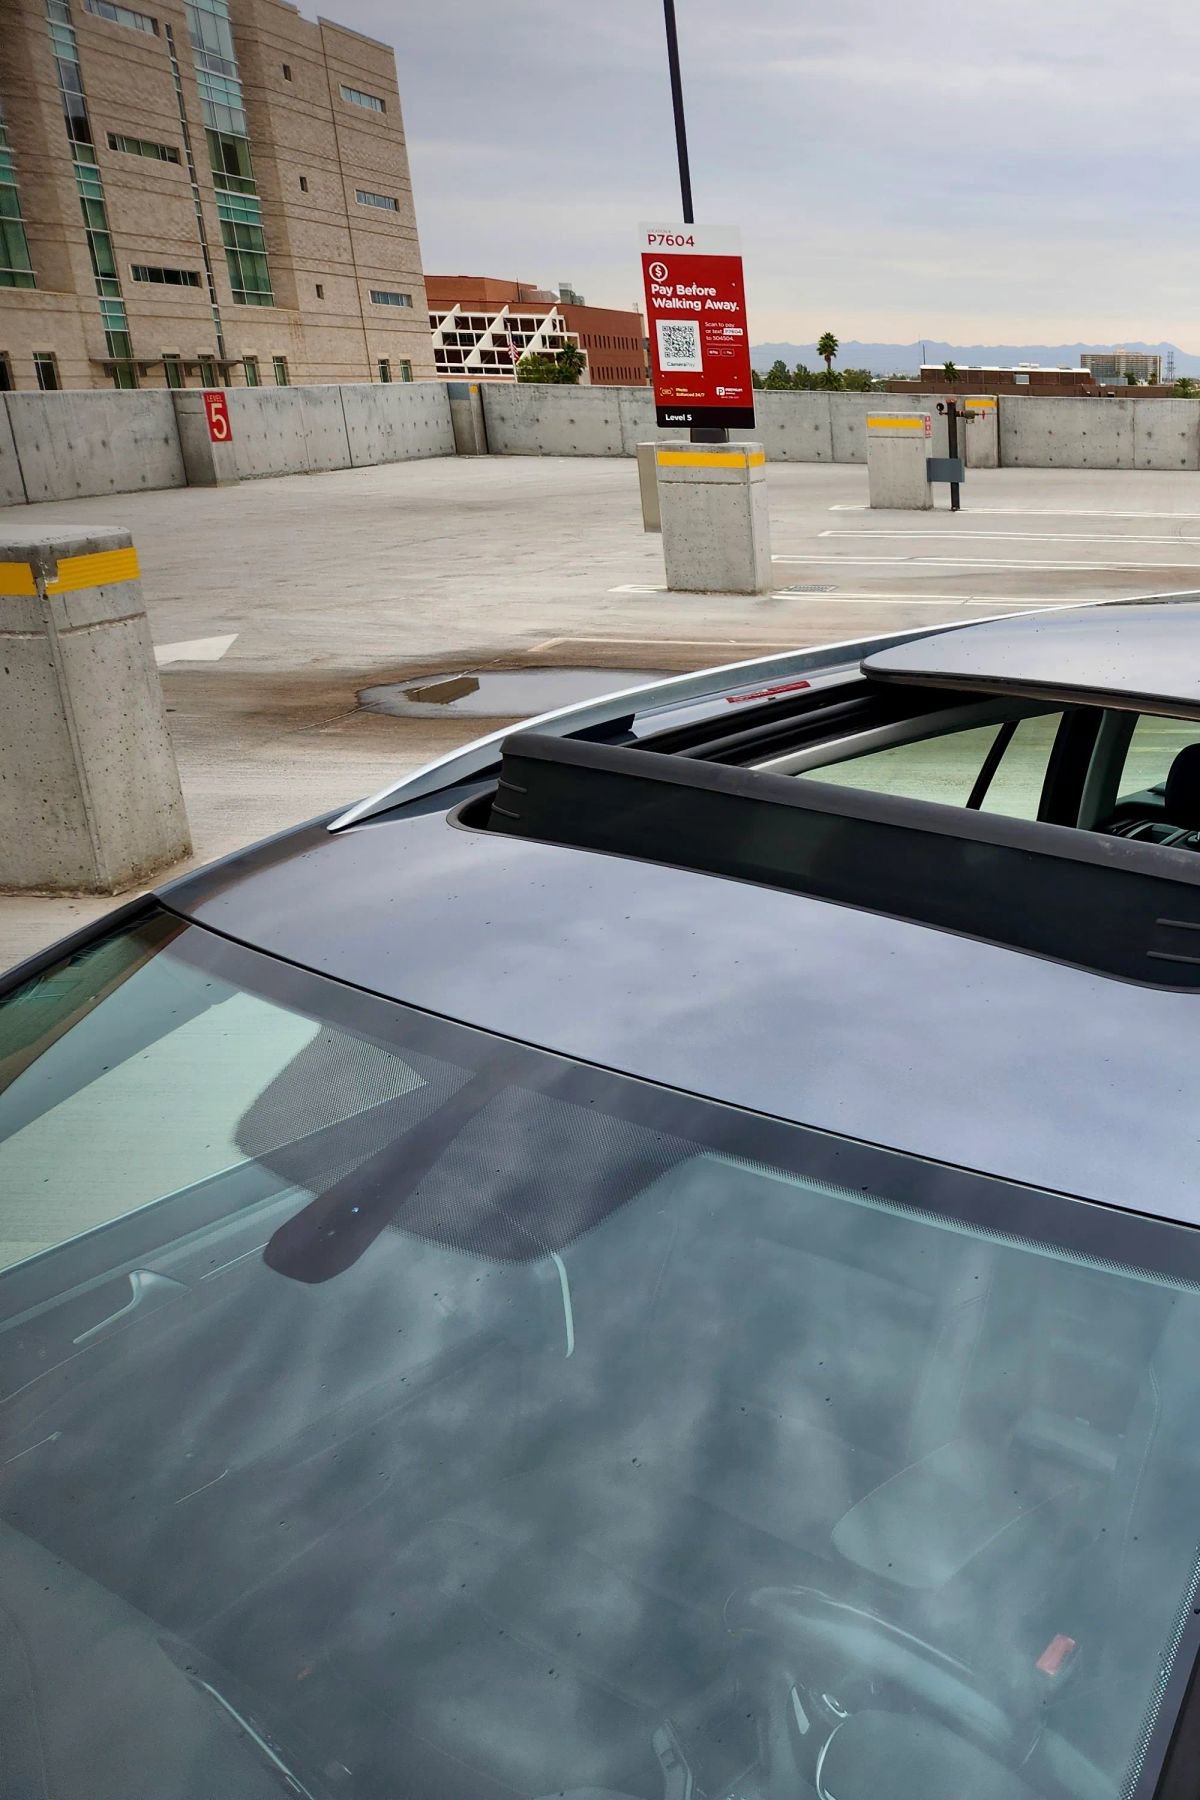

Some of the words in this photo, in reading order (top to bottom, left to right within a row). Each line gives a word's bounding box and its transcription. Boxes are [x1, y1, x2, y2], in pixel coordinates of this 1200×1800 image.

[647, 233, 695, 247] P7604
[651, 283, 673, 297] Pay
[676, 284, 717, 296] Before
[652, 297, 702, 311] Walking
[704, 299, 740, 312] Away.
[206, 394, 224, 403] LEVEL
[211, 402, 227, 439] 5
[665, 413, 686, 421] Level
